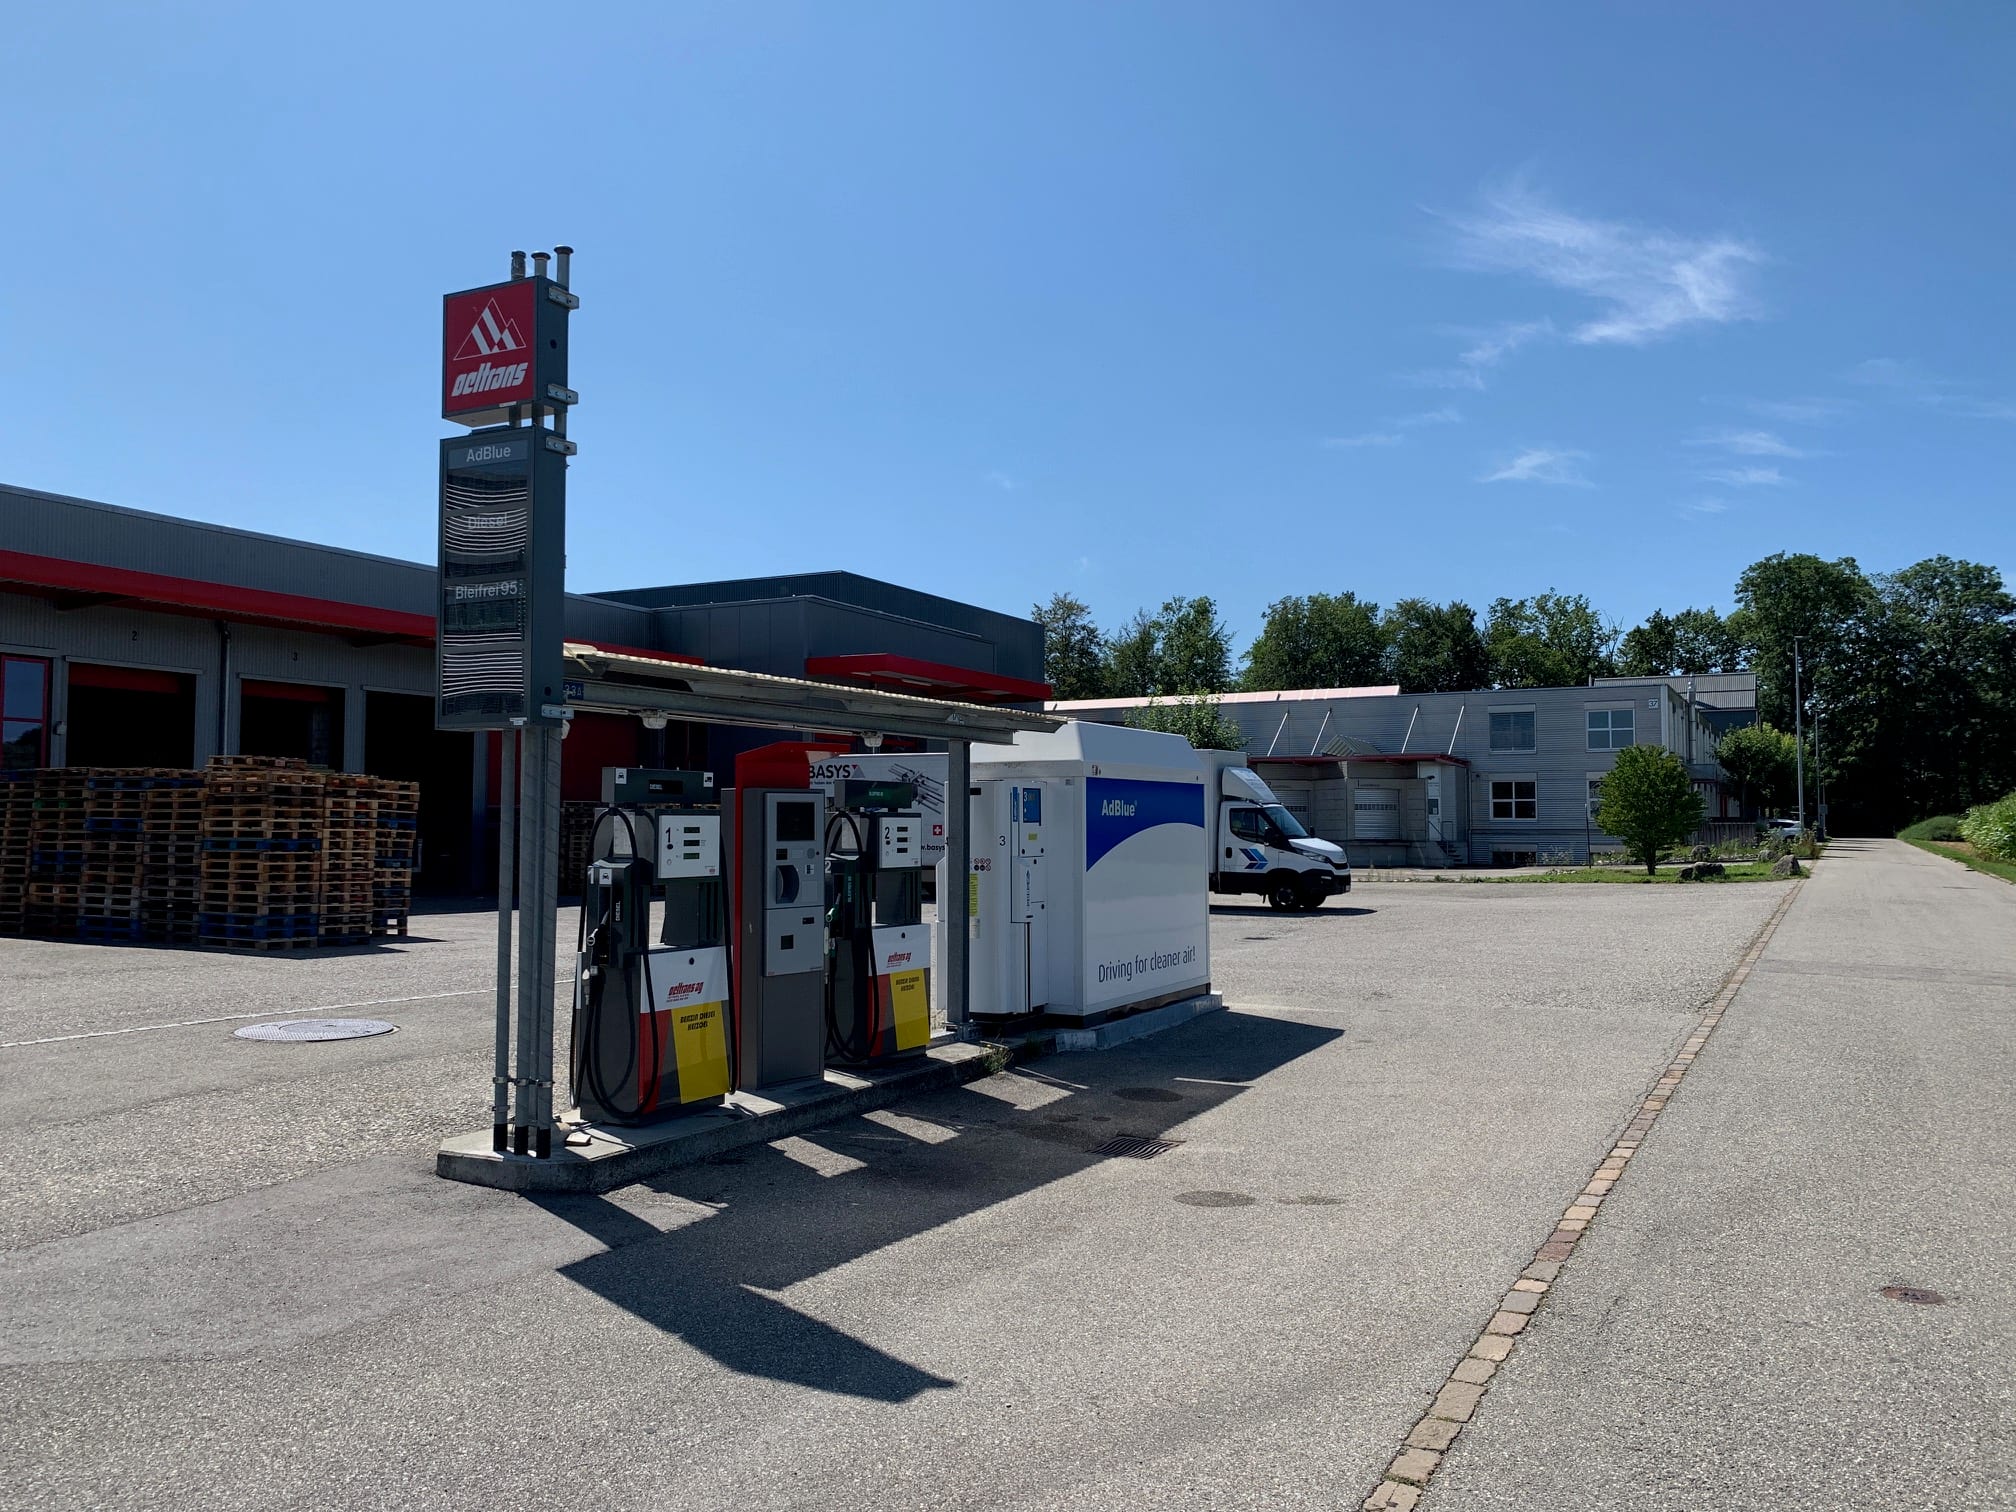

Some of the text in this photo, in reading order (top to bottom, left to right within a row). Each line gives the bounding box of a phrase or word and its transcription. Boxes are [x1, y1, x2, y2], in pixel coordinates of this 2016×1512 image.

[451, 362, 529, 397] oeltrans
[466, 445, 511, 463] AdBlue
[467, 512, 508, 530] Diesel
[132, 631, 138, 641] 2
[292, 652, 298, 662] 3
[809, 764, 850, 779] BASYS
[665, 827, 672, 843] 1
[884, 826, 890, 840] 2
[999, 835, 1006, 846] 3
[825, 861, 832, 874] 2
[587, 867, 595, 885] 1
[1098, 945, 1196, 983] Driving for cleaner air!
